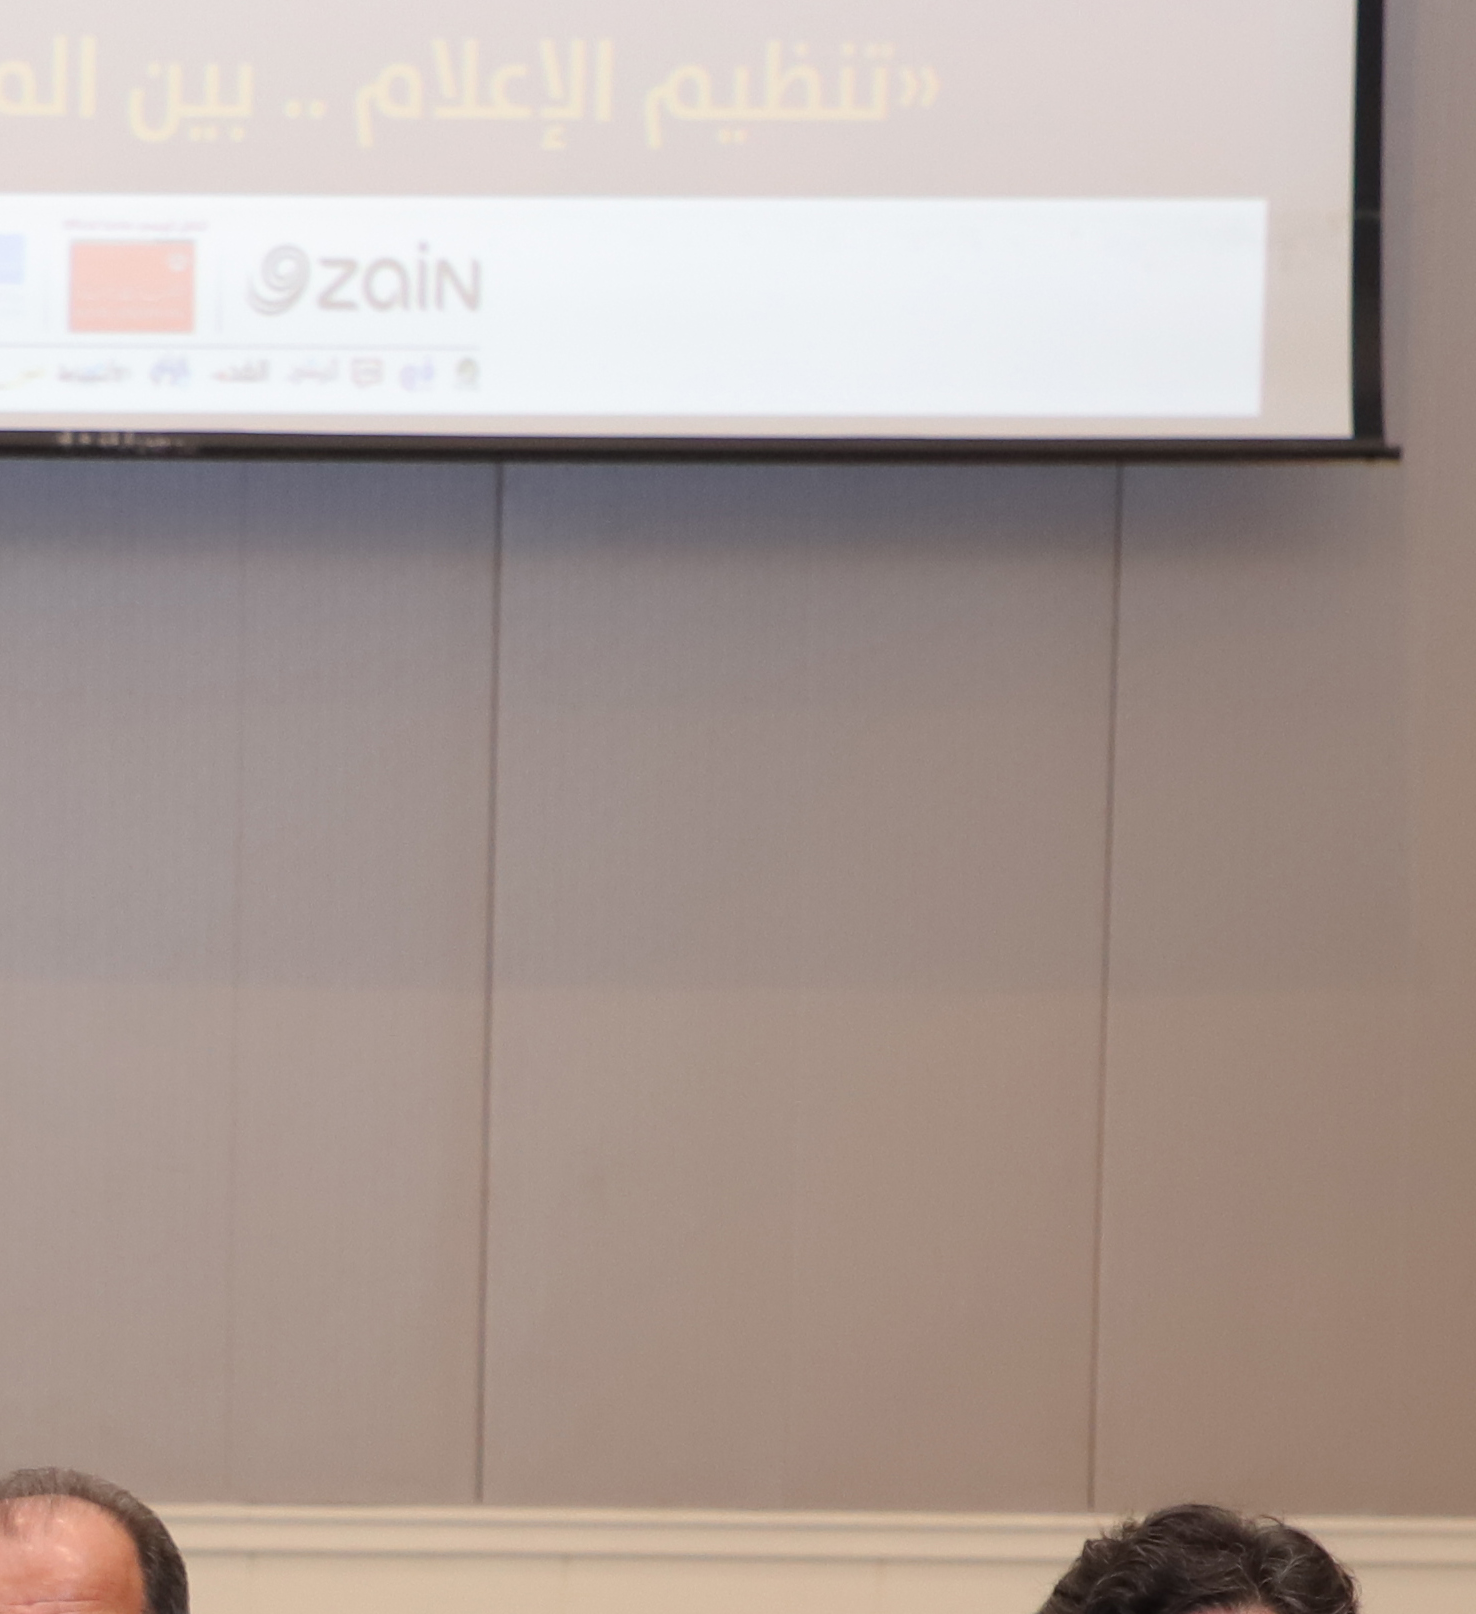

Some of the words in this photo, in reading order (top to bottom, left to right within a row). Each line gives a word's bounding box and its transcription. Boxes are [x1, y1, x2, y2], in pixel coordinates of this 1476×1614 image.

[127, 60, 255, 143] بين
[354, 36, 615, 150] الإعلام
[645, 38, 942, 150] «تنظيم
[316, 240, 482, 313] zain
